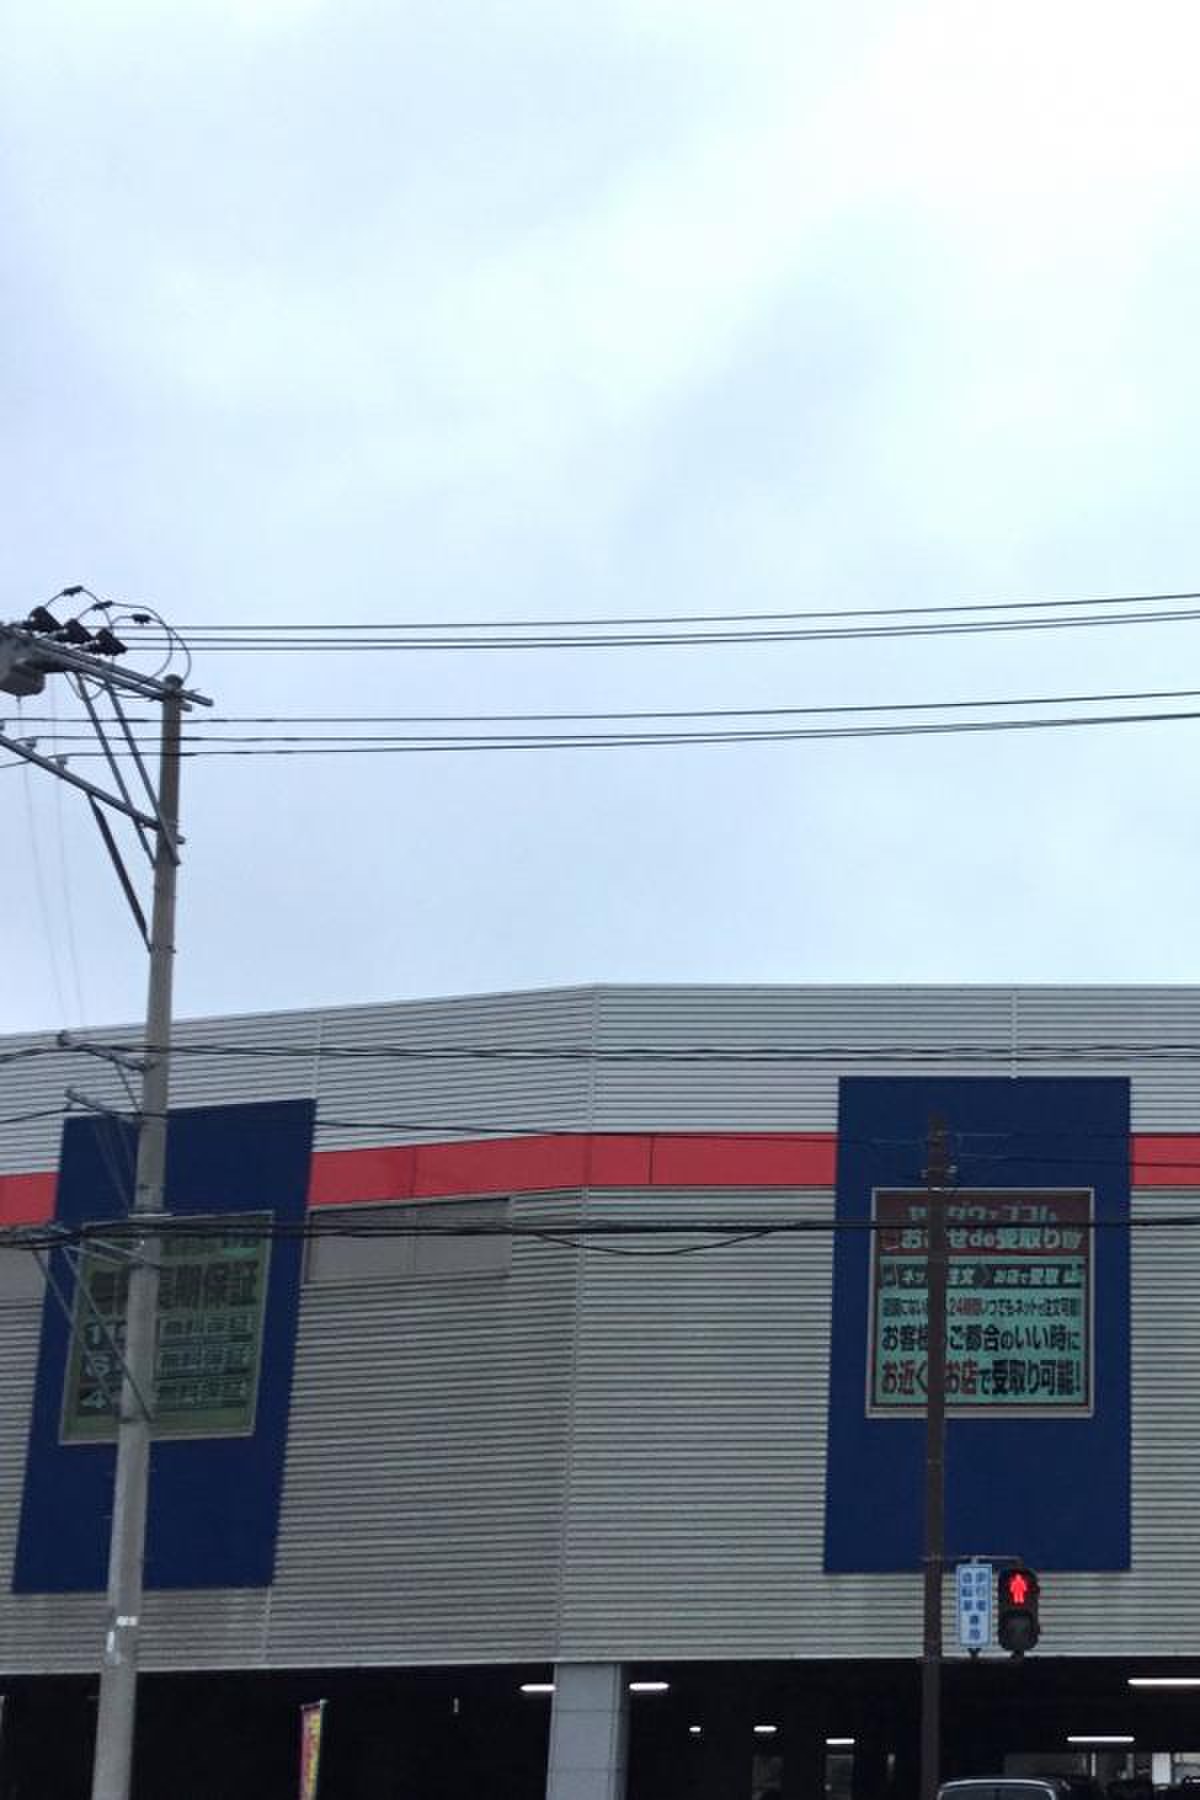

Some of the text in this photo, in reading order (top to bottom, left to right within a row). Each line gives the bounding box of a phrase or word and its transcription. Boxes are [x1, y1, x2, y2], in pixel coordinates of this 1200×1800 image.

[882, 1324, 1081, 1351] お客様ご都合のいい時に
[882, 1359, 1081, 1396] お近くお店で受取り可能!
